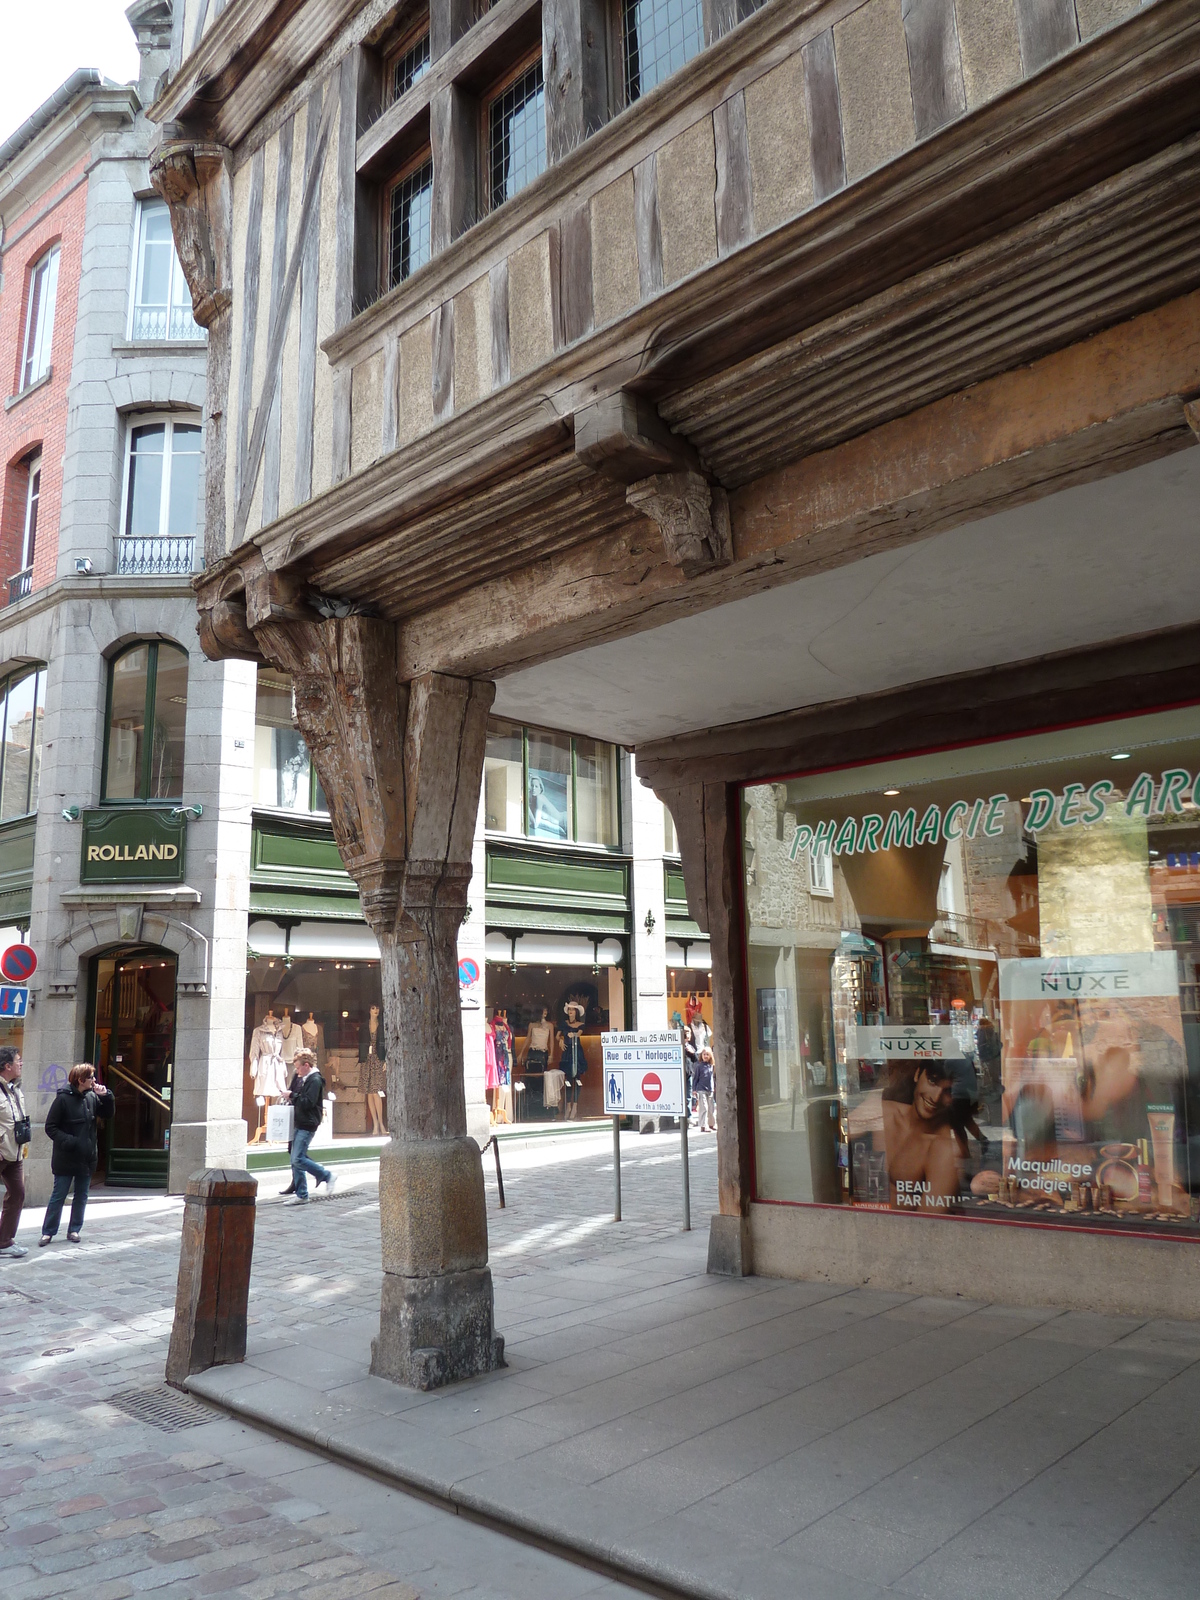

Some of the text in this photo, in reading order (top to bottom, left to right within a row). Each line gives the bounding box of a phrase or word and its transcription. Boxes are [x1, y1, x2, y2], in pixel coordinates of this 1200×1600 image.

[788, 768, 1200, 861] PHARMACIE DES AR
[87, 844, 178, 861] ROLLAND
[1041, 975, 1130, 992] NUXE
[601, 1035, 609, 1043] du
[611, 1035, 618, 1043] 10
[619, 1034, 637, 1043] AVRIL
[649, 1034, 657, 1042] 25
[659, 1033, 679, 1042] AVRIL
[880, 1040, 942, 1050] NUXE
[606, 1051, 619, 1060] Rue
[623, 1050, 632, 1060] de
[1008, 1157, 1093, 1178] Maquillage
[896, 1181, 931, 1193] BEAU
[1008, 1174, 1087, 1194] rodigie
[896, 1194, 979, 1208] PAR NATU
